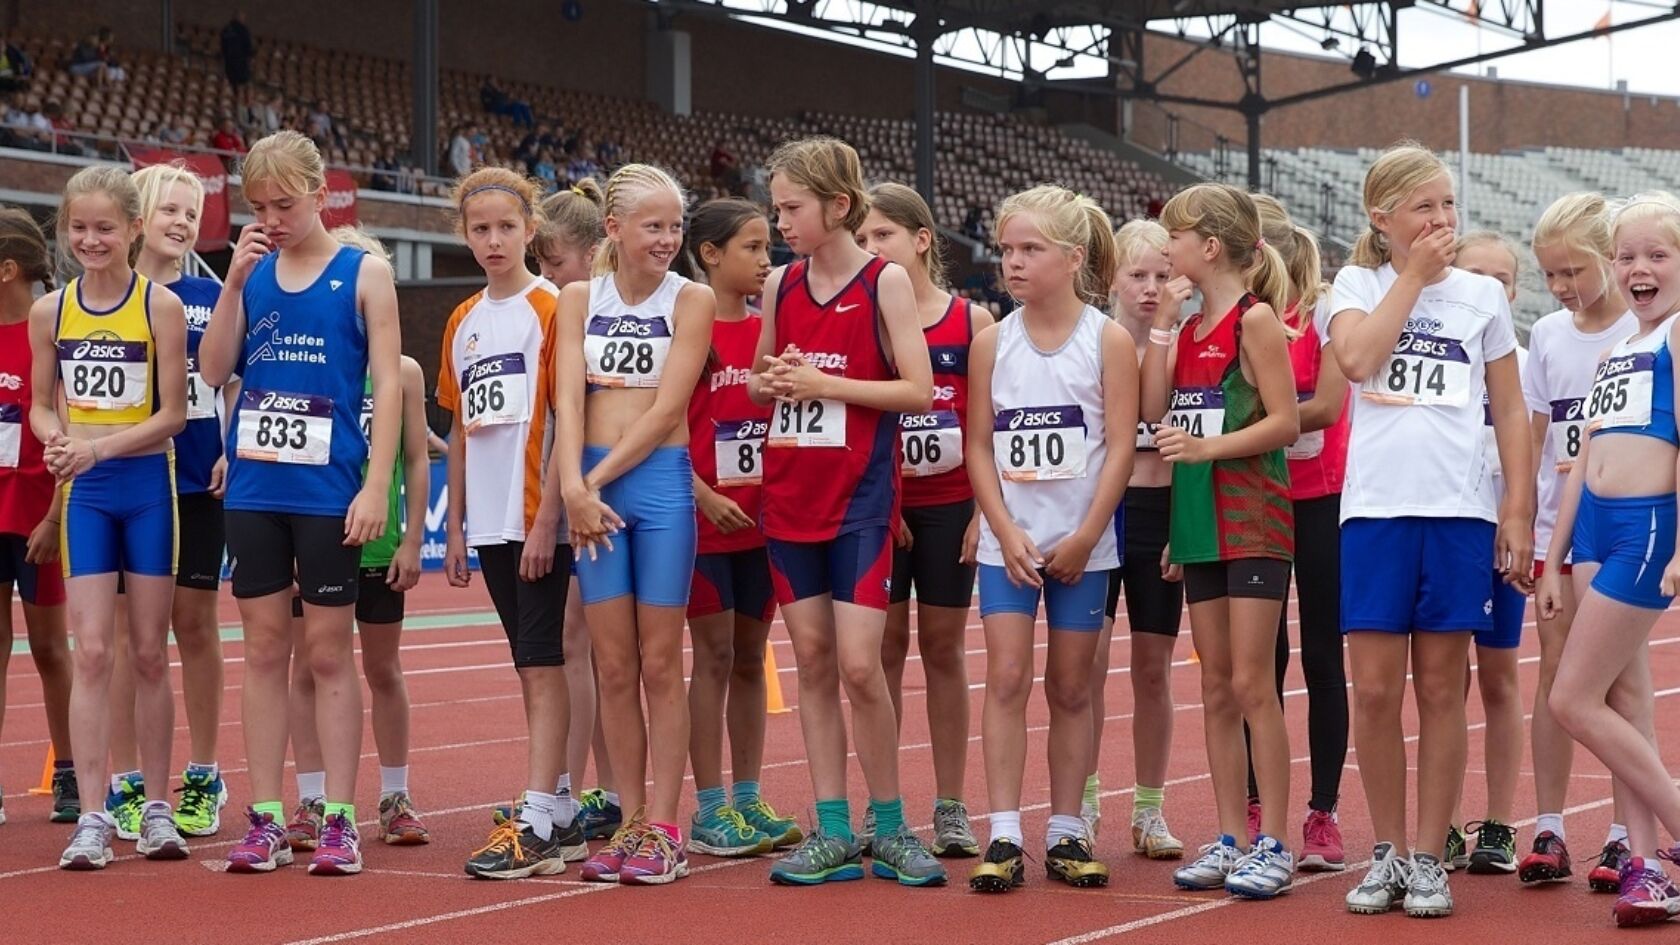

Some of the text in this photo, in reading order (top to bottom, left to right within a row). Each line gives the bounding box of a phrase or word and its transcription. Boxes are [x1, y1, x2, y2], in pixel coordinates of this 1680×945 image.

[272, 328, 325, 346] Leiden
[619, 320, 651, 336] asics
[90, 345, 125, 358] asics
[600, 341, 653, 374] 828
[74, 365, 125, 397] 820
[475, 360, 503, 378] asics
[1388, 358, 1446, 396] 814
[274, 396, 310, 411] asics
[468, 380, 505, 419] 836
[1178, 391, 1204, 406] asics
[1588, 378, 1630, 418] 865
[256, 415, 307, 449] 833
[780, 400, 824, 434] 812
[903, 415, 938, 428] asics
[1023, 411, 1062, 426] asics
[738, 442, 765, 473] 8
[901, 434, 941, 466] 06
[1010, 432, 1064, 467] 810
